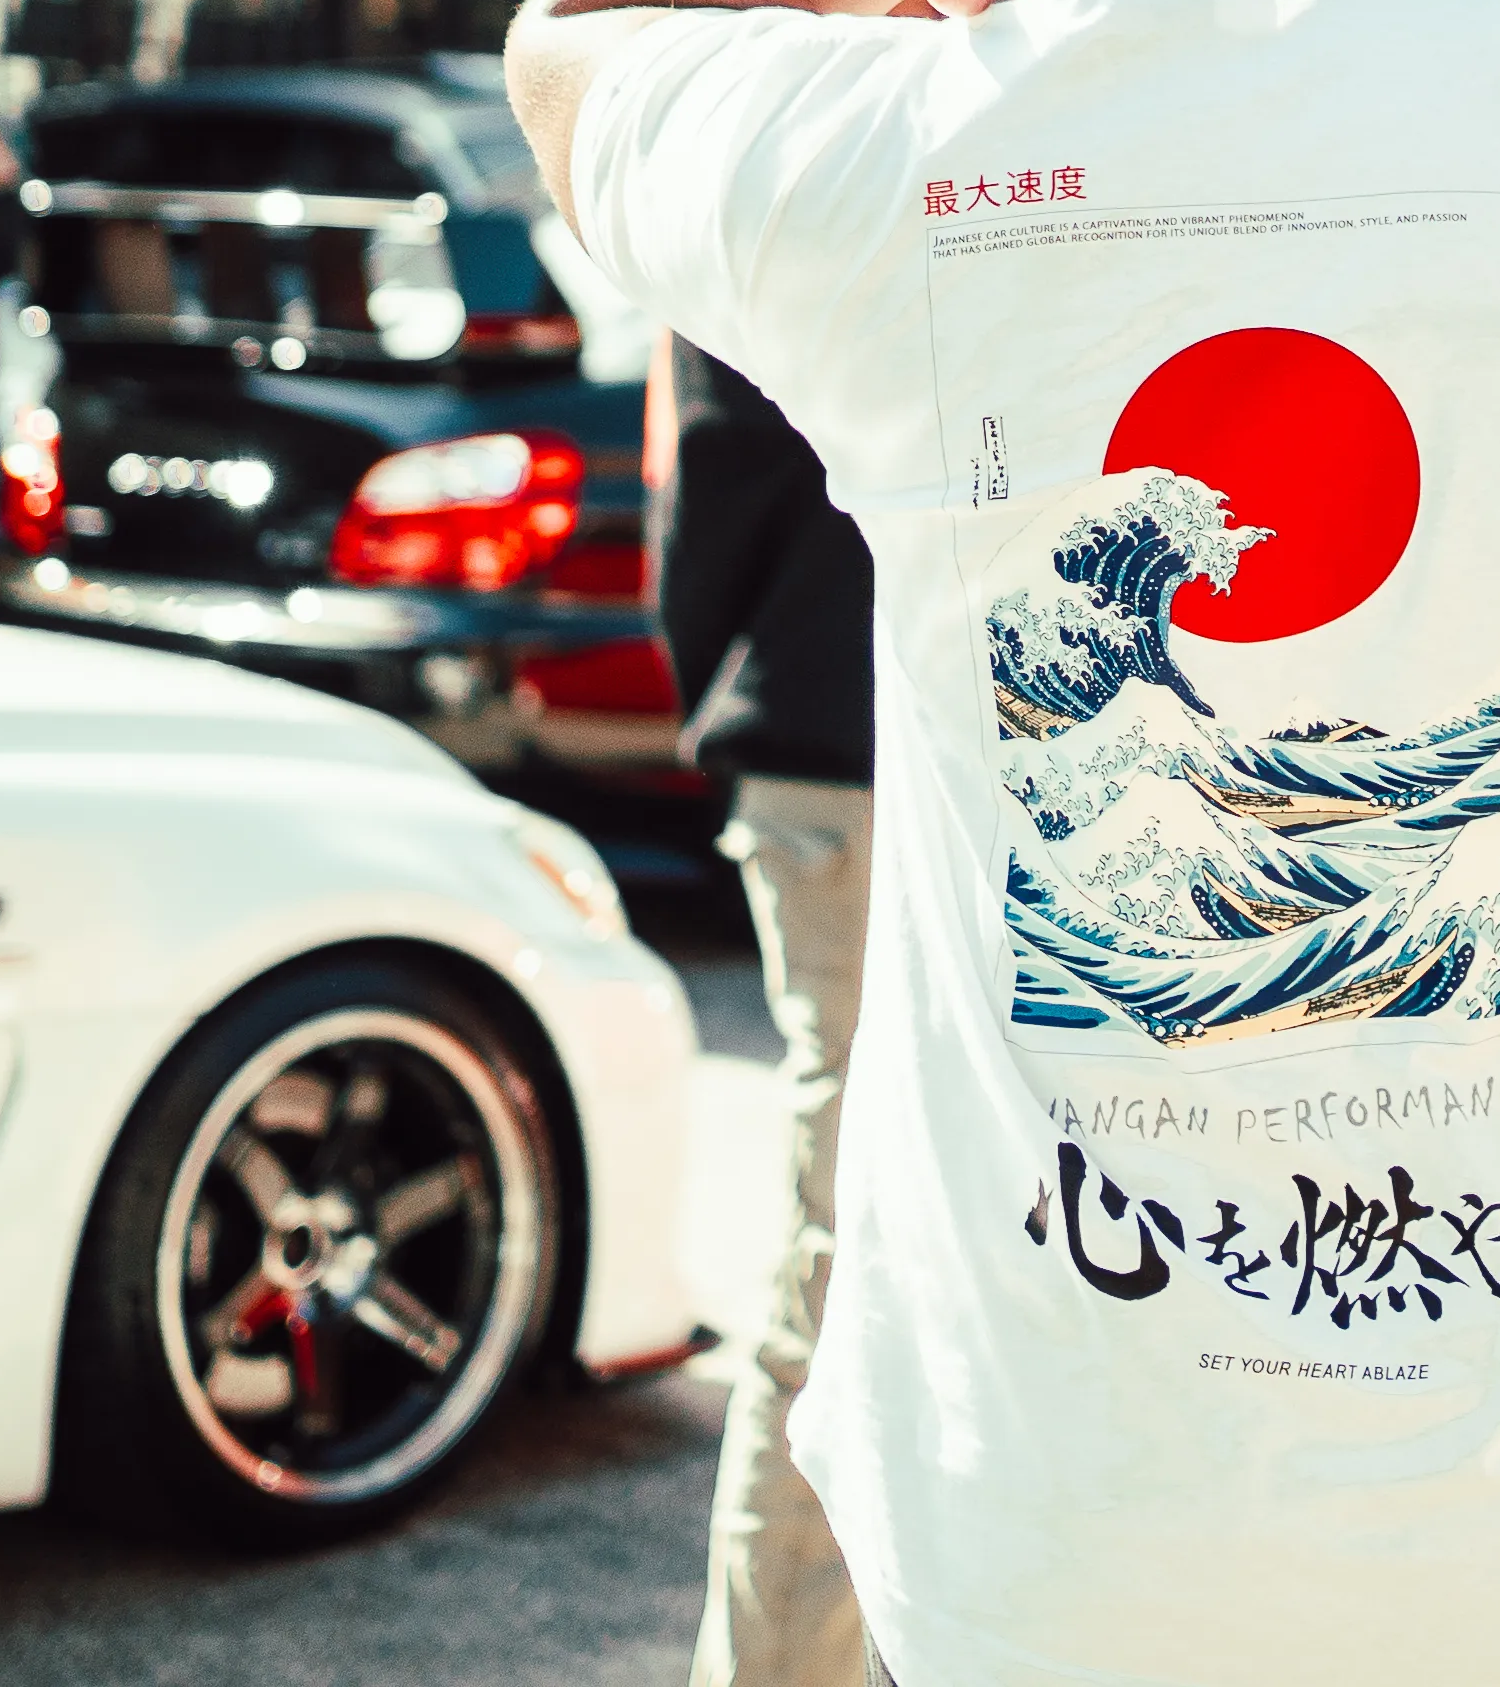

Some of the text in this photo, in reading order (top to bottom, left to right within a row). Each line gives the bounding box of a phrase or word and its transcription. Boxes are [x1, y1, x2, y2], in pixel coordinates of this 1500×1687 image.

[924, 165, 1087, 216] 最大速度
[932, 248, 957, 259] THAT
[960, 245, 981, 255] HAS
[984, 240, 1023, 252] GAINED
[1026, 235, 1067, 247] GLOBAL
[1071, 230, 1143, 243] RECOGNITION
[1146, 229, 1168, 238] FOR
[1170, 228, 1186, 237] ITS
[1189, 226, 1229, 236] UNIQUE
[1233, 224, 1267, 235] BLEND
[1270, 223, 1284, 233] OF
[1396, 214, 1419, 224] AND
[1422, 213, 1468, 222] PASSION
[933, 212, 1304, 248] JAPANESE CAR CULTURE IS A CAPTIVATING AND VIBRANT PHENOMENON
[1198, 1352, 1431, 1382] SET YOUR HEART ABLAZE
